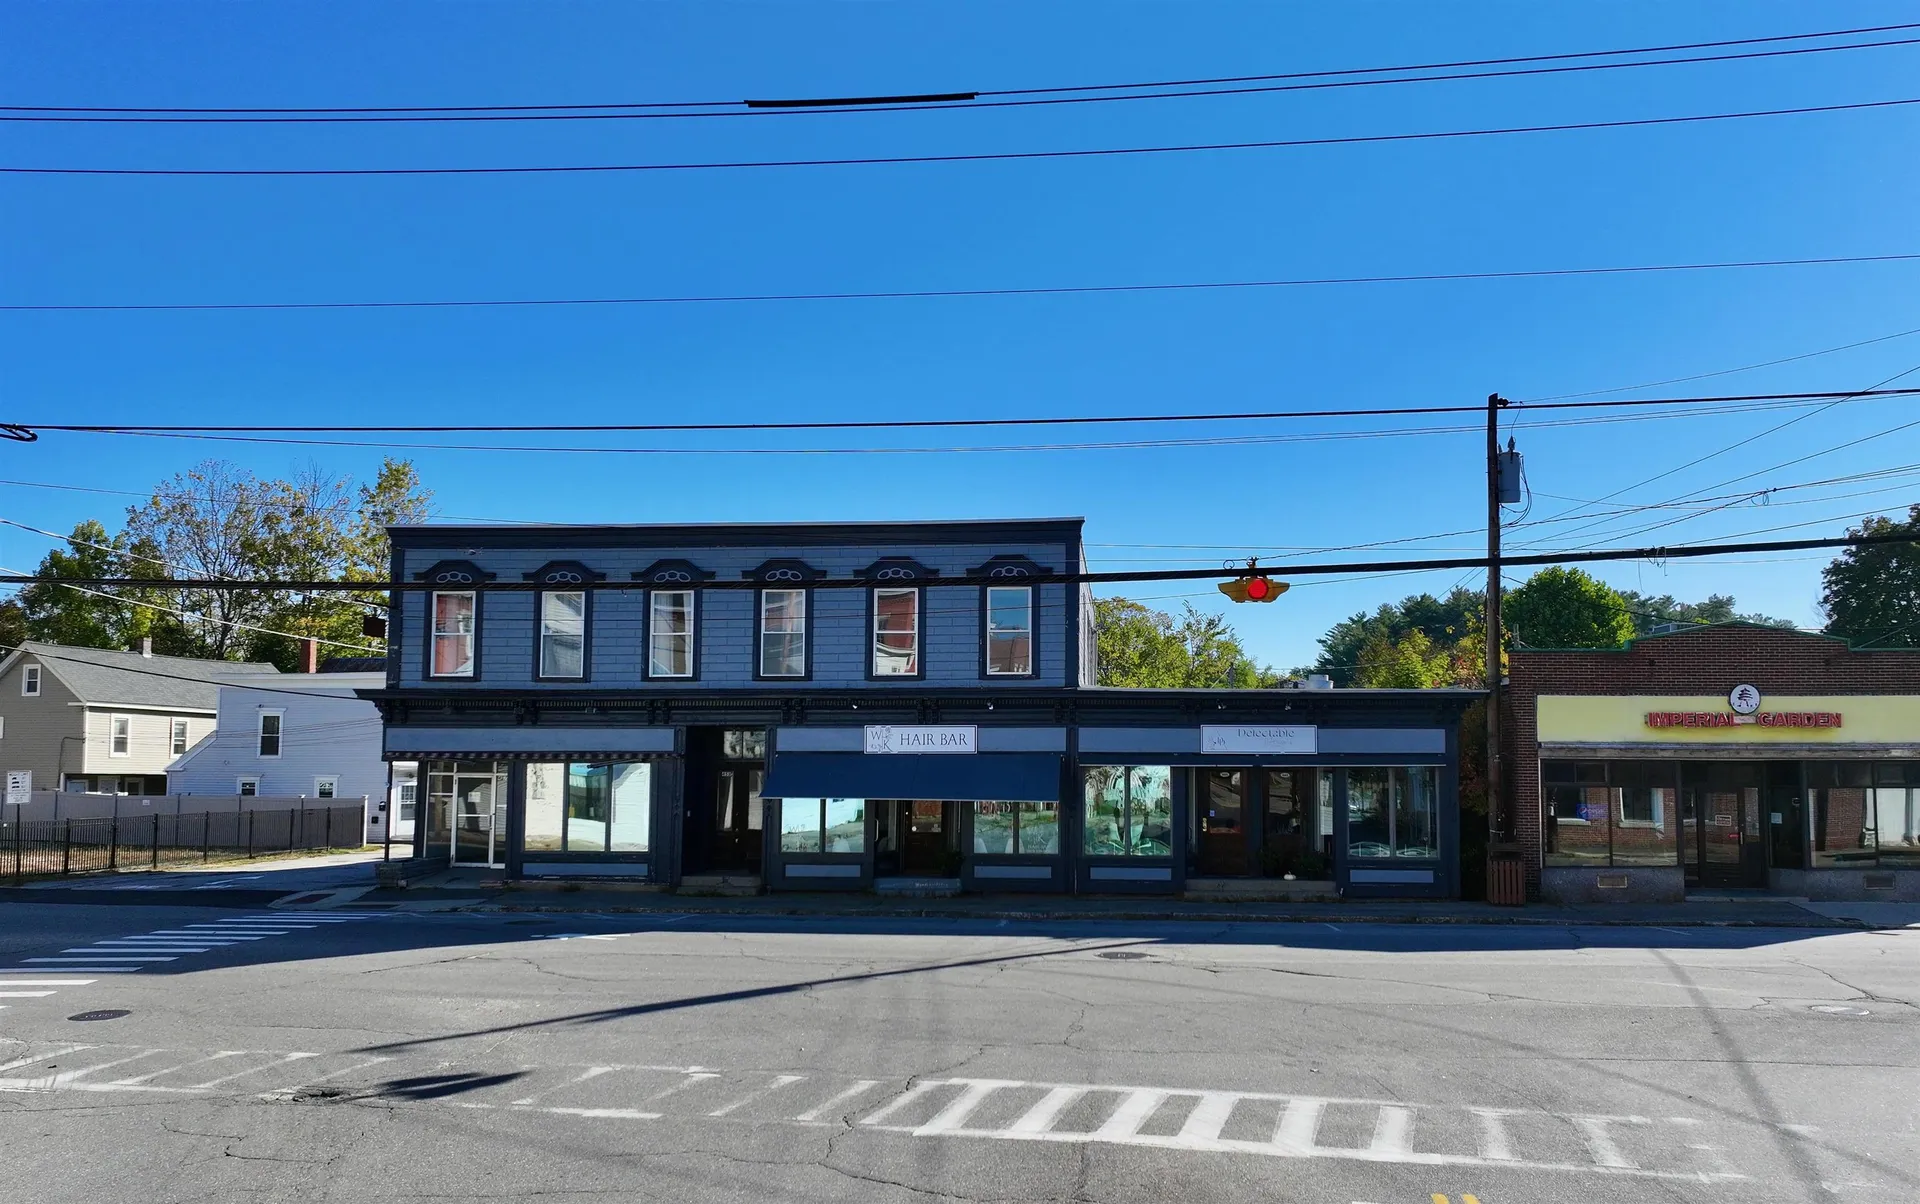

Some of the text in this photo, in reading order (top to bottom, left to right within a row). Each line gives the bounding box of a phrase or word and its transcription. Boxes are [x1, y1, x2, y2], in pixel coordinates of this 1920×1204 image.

[1647, 711, 1843, 728] IMPERIAL GARDEN
[900, 733, 968, 746] HAIR BAR
[1237, 728, 1295, 738] Delectable
